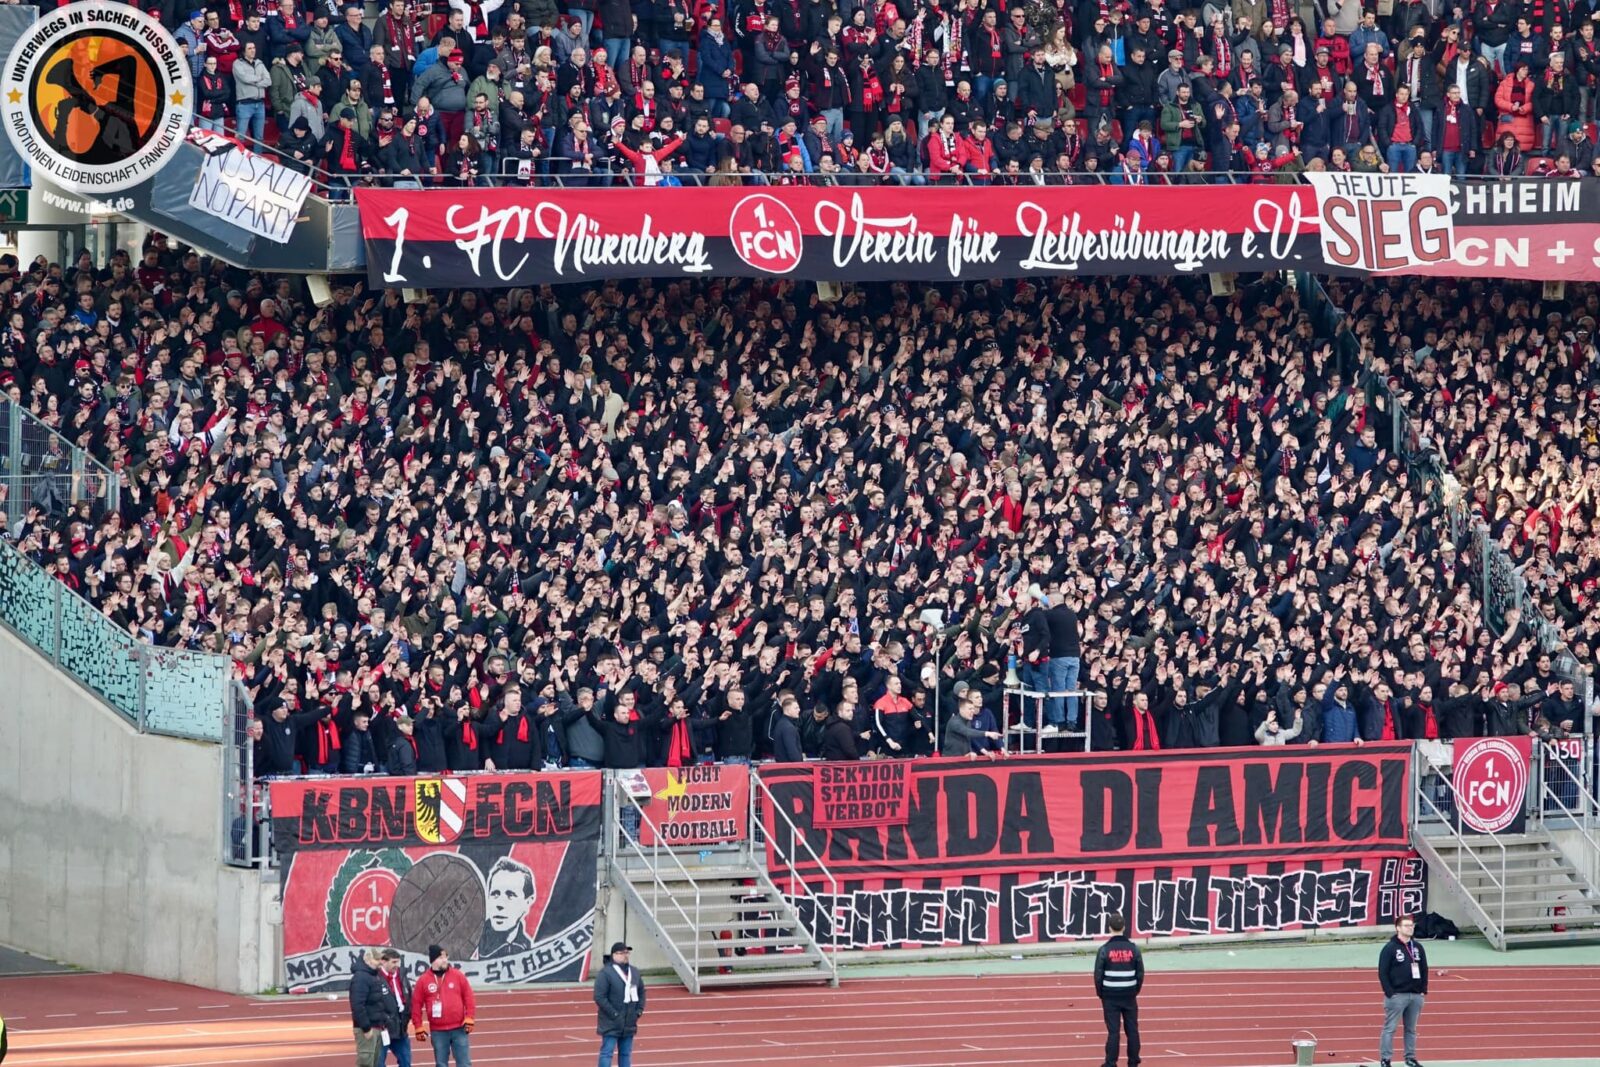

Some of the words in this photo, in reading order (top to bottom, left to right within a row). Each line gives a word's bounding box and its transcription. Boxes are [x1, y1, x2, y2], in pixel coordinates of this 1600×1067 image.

[1330, 174, 1418, 198] HEUTE
[227, 188, 298, 239] PARTY
[754, 202, 775, 228] 1.
[383, 207, 432, 283] 1.
[446, 203, 532, 281] FC
[533, 201, 713, 277] Nürnberg
[740, 230, 797, 260] FCN
[814, 192, 937, 268] Verein
[947, 212, 1000, 277] für
[1322, 195, 1452, 270] SIEG
[677, 766, 721, 785] FIGHT
[820, 764, 904, 784] SEKTION
[1485, 757, 1500, 779] 1.
[667, 791, 733, 812] MODERN
[820, 782, 904, 802] STADION
[1079, 767, 1163, 853] DI
[1187, 758, 1407, 848] AMICI
[1468, 780, 1511, 807] FCN
[300, 786, 406, 842] KBN
[474, 780, 573, 836] FCN
[824, 801, 900, 820] VERBOT
[660, 818, 737, 840] FOOTBALL
[368, 880, 383, 903] 1.
[1011, 870, 1125, 939] FÜR
[287, 952, 342, 981] MAX
